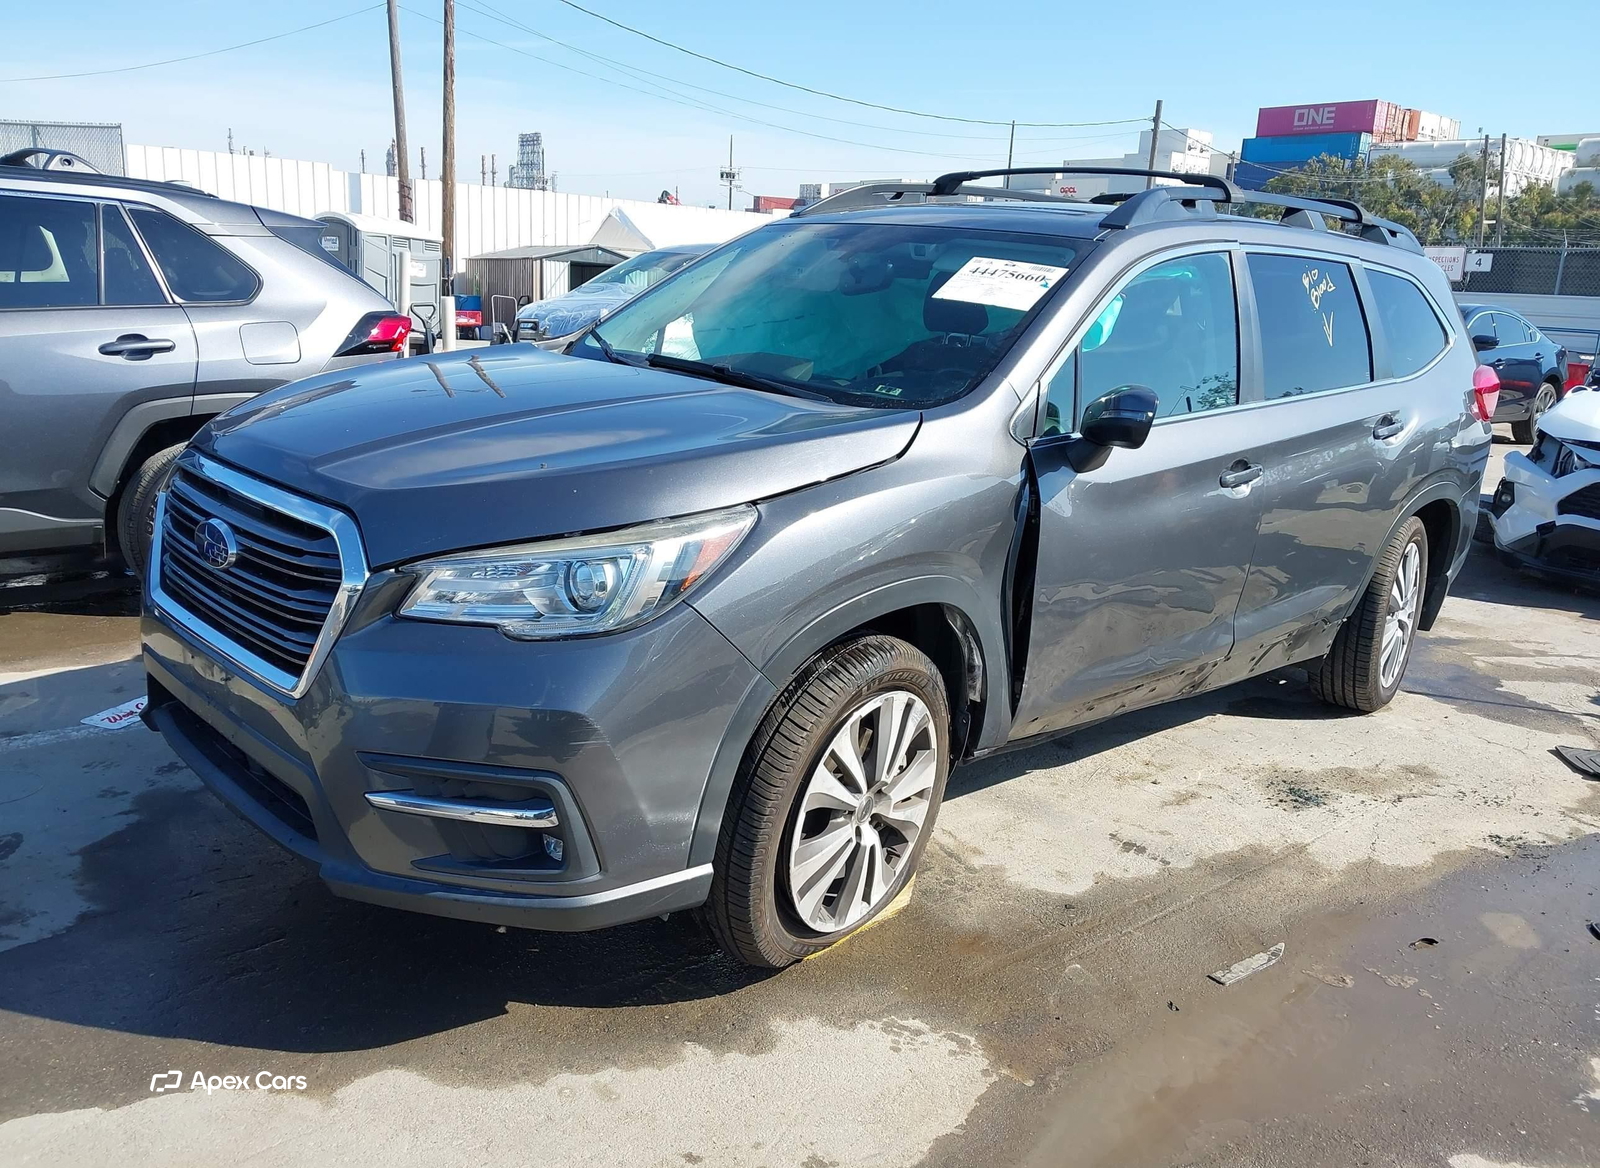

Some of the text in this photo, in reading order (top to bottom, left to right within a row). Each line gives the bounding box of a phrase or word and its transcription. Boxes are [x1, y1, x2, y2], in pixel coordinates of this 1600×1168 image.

[1293, 106, 1336, 126] ONE
[1475, 258, 1482, 267] 4
[969, 266, 1046, 283] 44475660
